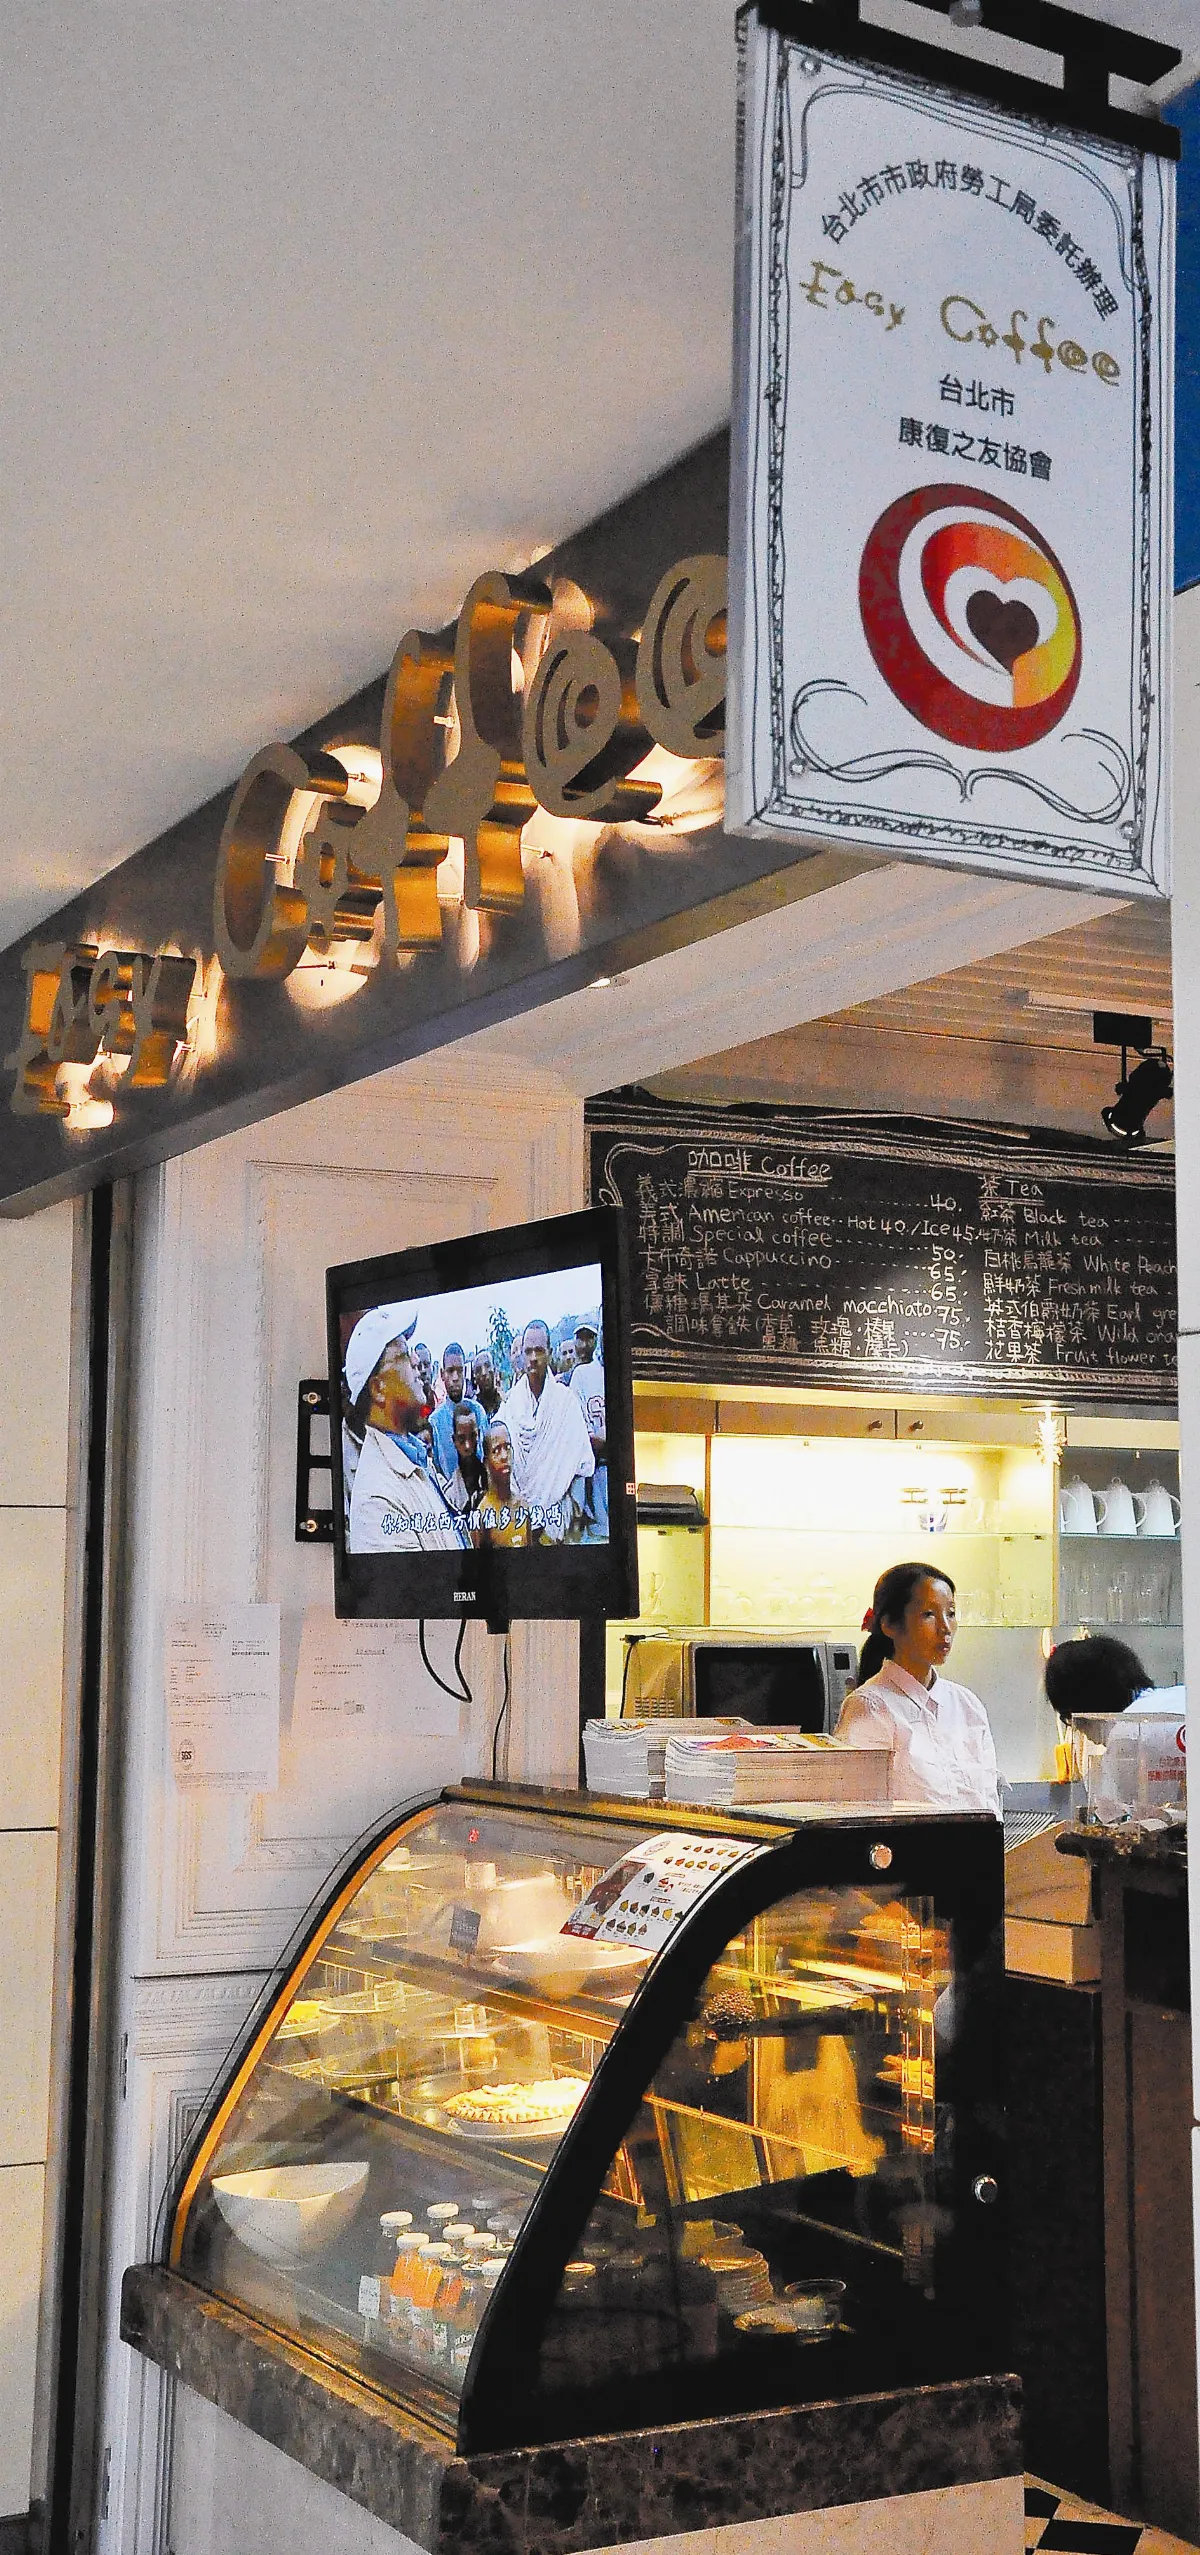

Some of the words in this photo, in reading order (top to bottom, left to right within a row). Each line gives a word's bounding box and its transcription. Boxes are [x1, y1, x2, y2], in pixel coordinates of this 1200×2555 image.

[821, 157, 1120, 320] 台北市市政府勞工局委託辦理
[799, 260, 906, 331] Easy
[940, 295, 1122, 387] Coffee
[939, 373, 1015, 417] 台北市
[898, 416, 1053, 482] 康復之友協會
[4, 940, 168, 1113] Easy
[688, 1148, 752, 1176] 咖啡
[761, 1156, 831, 1179] Coffee
[729, 1180, 803, 1203] Expresso
[978, 1174, 999, 1197] 茶
[1005, 1179, 1044, 1198] Tea
[688, 1204, 775, 1223] American
[783, 1207, 832, 1227] coffee
[848, 1215, 876, 1231] Hot
[979, 1202, 1016, 1225] 紅茶
[1024, 1206, 1067, 1225] Black
[1079, 1210, 1110, 1229] tea
[637, 1218, 685, 1245] 特調
[689, 1224, 764, 1250] Special
[772, 1227, 833, 1248] coffee
[1025, 1231, 1061, 1247] Milk
[1072, 1232, 1104, 1247] tea
[723, 1247, 832, 1269] Cappuccino
[1083, 1254, 1131, 1273] White
[696, 1271, 752, 1293] Latte
[1049, 1276, 1087, 1296] Fresh
[1130, 1281, 1158, 1297] tea
[757, 1293, 832, 1312] Caramel
[843, 1295, 932, 1317] macchiato
[1107, 1303, 1142, 1322] Earl
[1097, 1322, 1140, 1344] Wild
[984, 1341, 1042, 1364] 花果茶
[1056, 1343, 1099, 1364] Fruit
[1107, 1346, 1156, 1367] flower
[381, 1502, 564, 1535] 你知道在西方價值多少錢嗎
